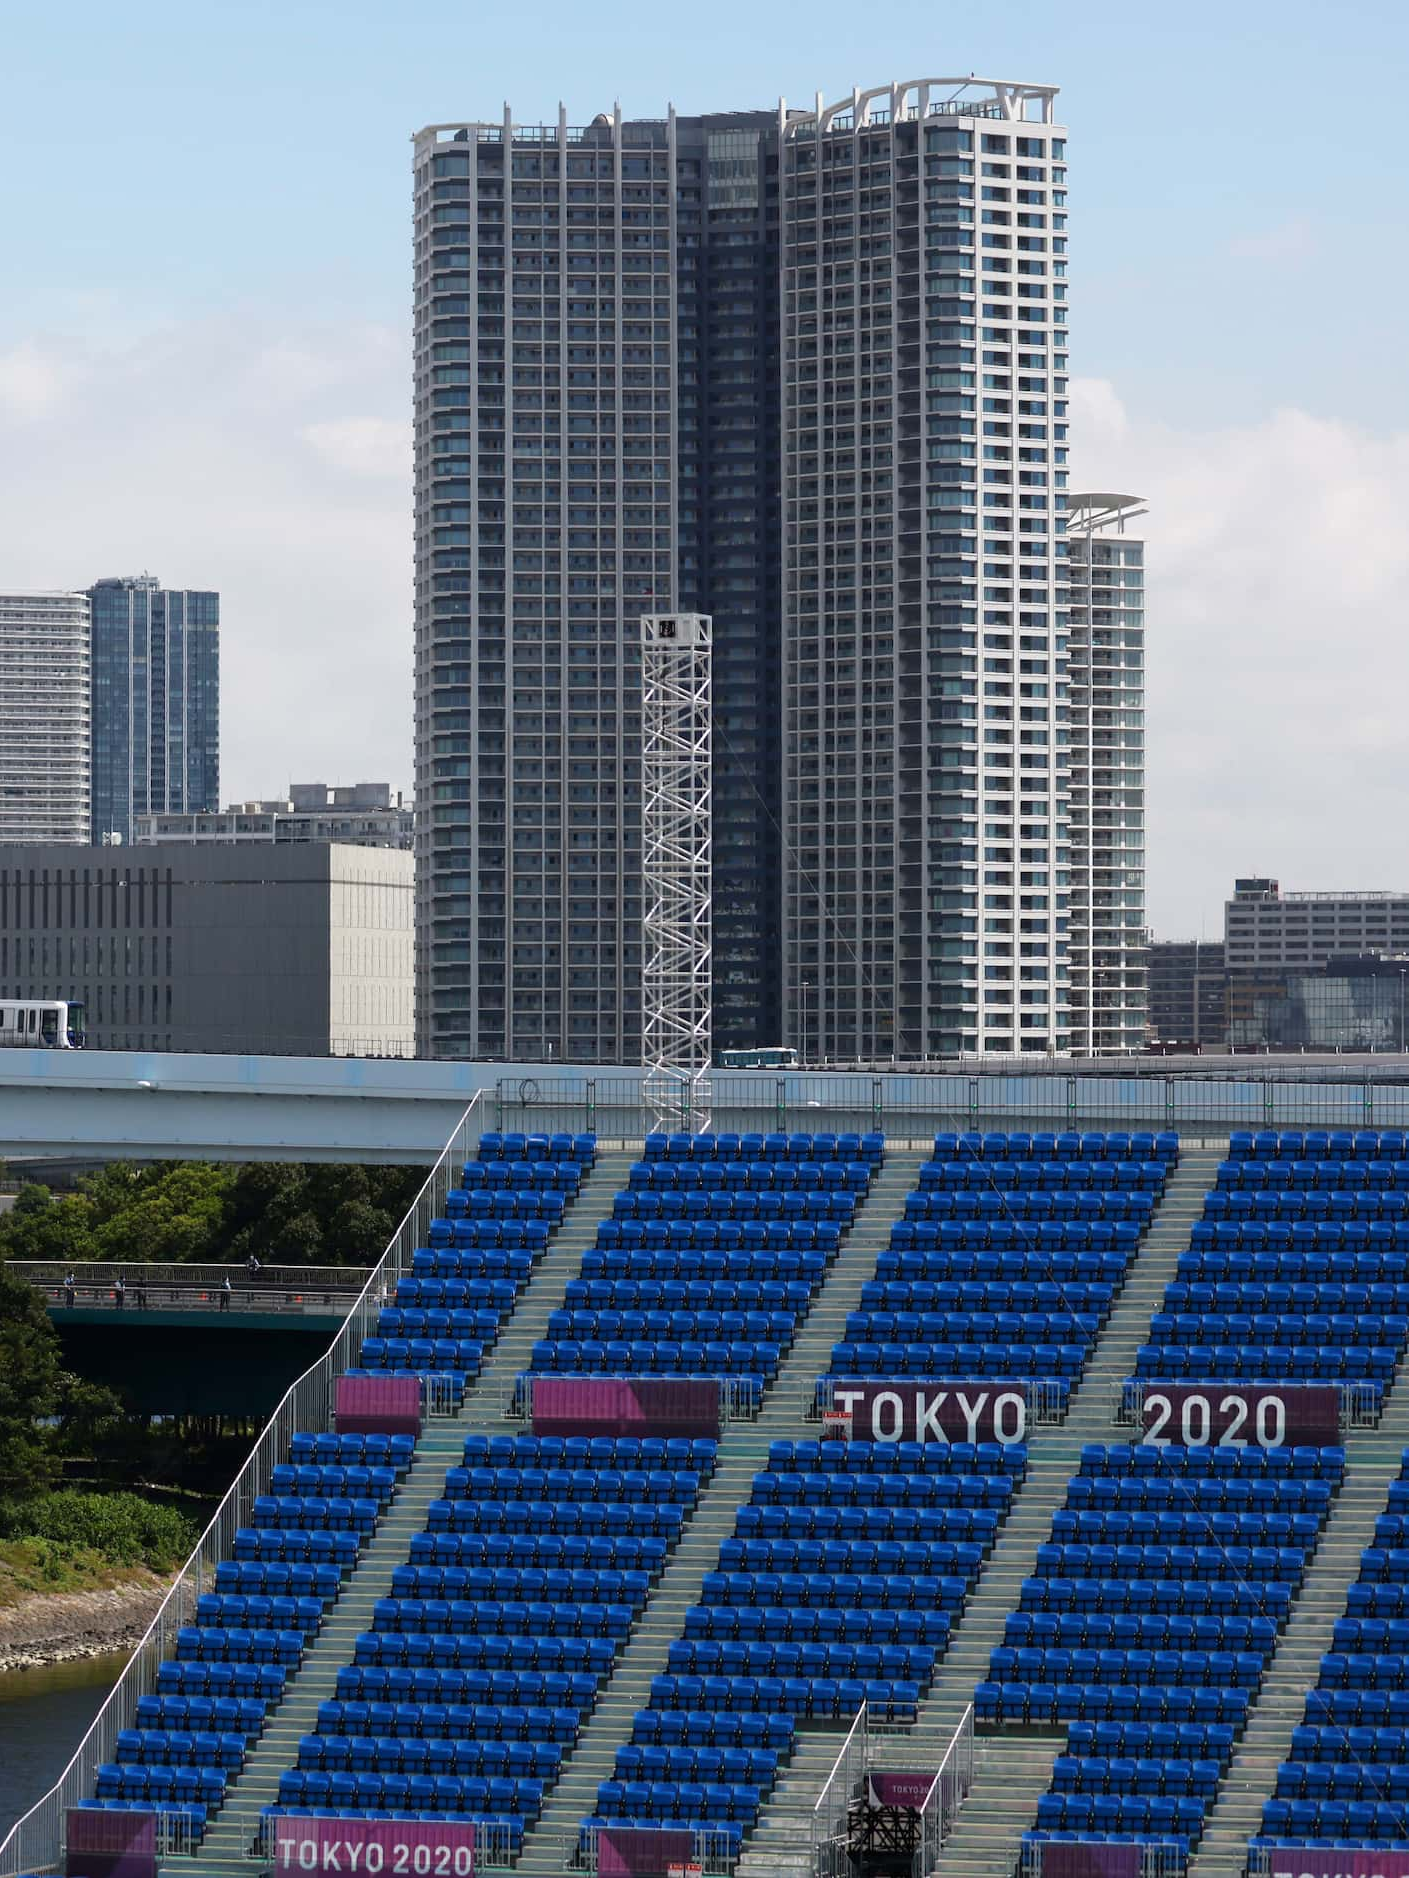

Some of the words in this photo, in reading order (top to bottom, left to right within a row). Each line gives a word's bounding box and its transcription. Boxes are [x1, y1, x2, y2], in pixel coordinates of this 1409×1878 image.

[834, 1391, 1026, 1444] TOKYO
[1143, 1394, 1286, 1447] 2020
[893, 1785, 919, 1795] TOKYO
[279, 1839, 384, 1872] TOKYO
[393, 1844, 471, 1876] 2020
